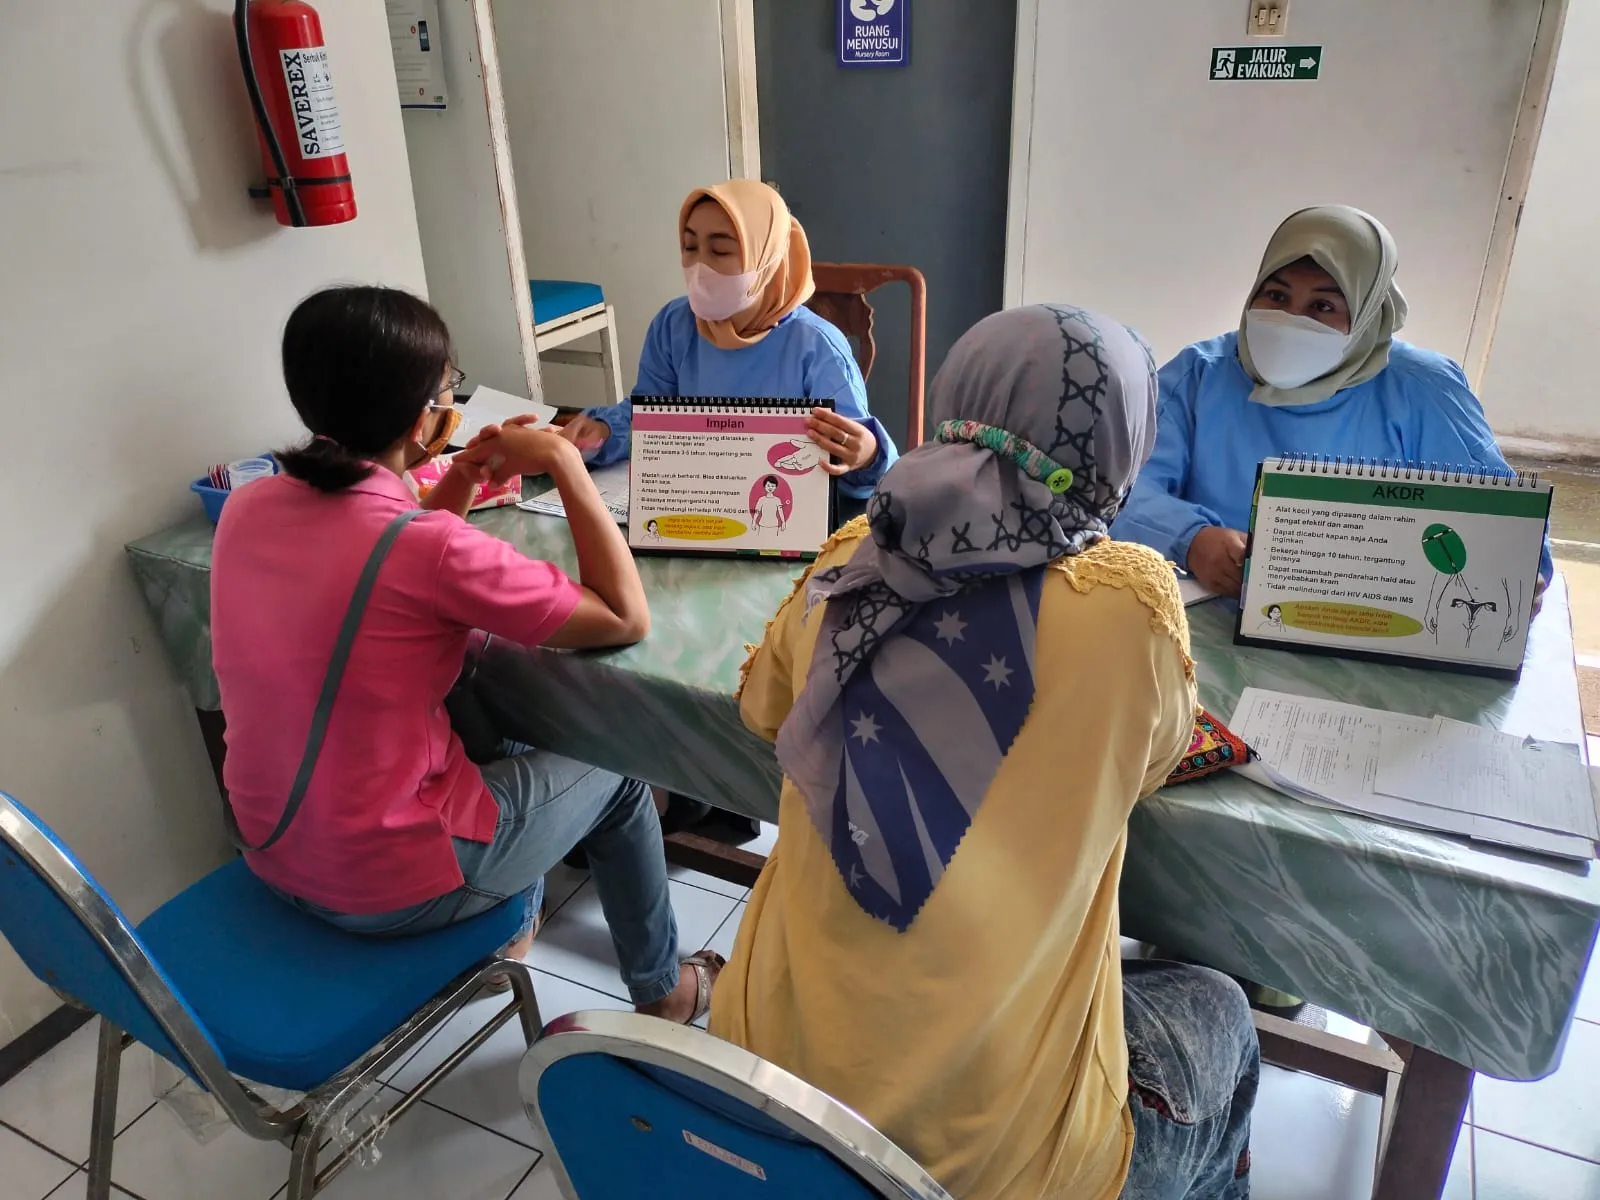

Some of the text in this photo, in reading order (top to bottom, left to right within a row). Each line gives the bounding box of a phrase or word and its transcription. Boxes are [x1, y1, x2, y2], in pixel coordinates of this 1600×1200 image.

[855, 25, 890, 37] RUANG
[847, 37, 898, 50] MENYUSUI
[854, 50, 875, 58] Nursery
[1249, 48, 1287, 63] JALUR
[1237, 63, 1296, 78] EVAKUASI
[283, 51, 321, 155] SAVEREX
[706, 417, 745, 430] Implan
[1372, 484, 1425, 501] AKDR
[1275, 517, 1300, 526] Sangat
[1302, 519, 1326, 527] efektif
[1311, 510, 1330, 518] yang
[1331, 511, 1366, 520] dipasang
[1394, 515, 1416, 523] rahim
[1272, 537, 1304, 545] inginkan
[1273, 529, 1388, 544] Dapat dicabut kapan saja Anda
[1269, 555, 1300, 564] jenisnya
[1270, 547, 1298, 556] Bekerja
[1300, 550, 1326, 559] hingga
[1364, 556, 1405, 566] tergantung
[1267, 573, 1318, 584] menyebabkan
[1268, 565, 1290, 574] Dapat
[1291, 567, 1332, 577] menambah
[1334, 572, 1378, 582] pendarahan
[1288, 585, 1329, 596] melindungi
